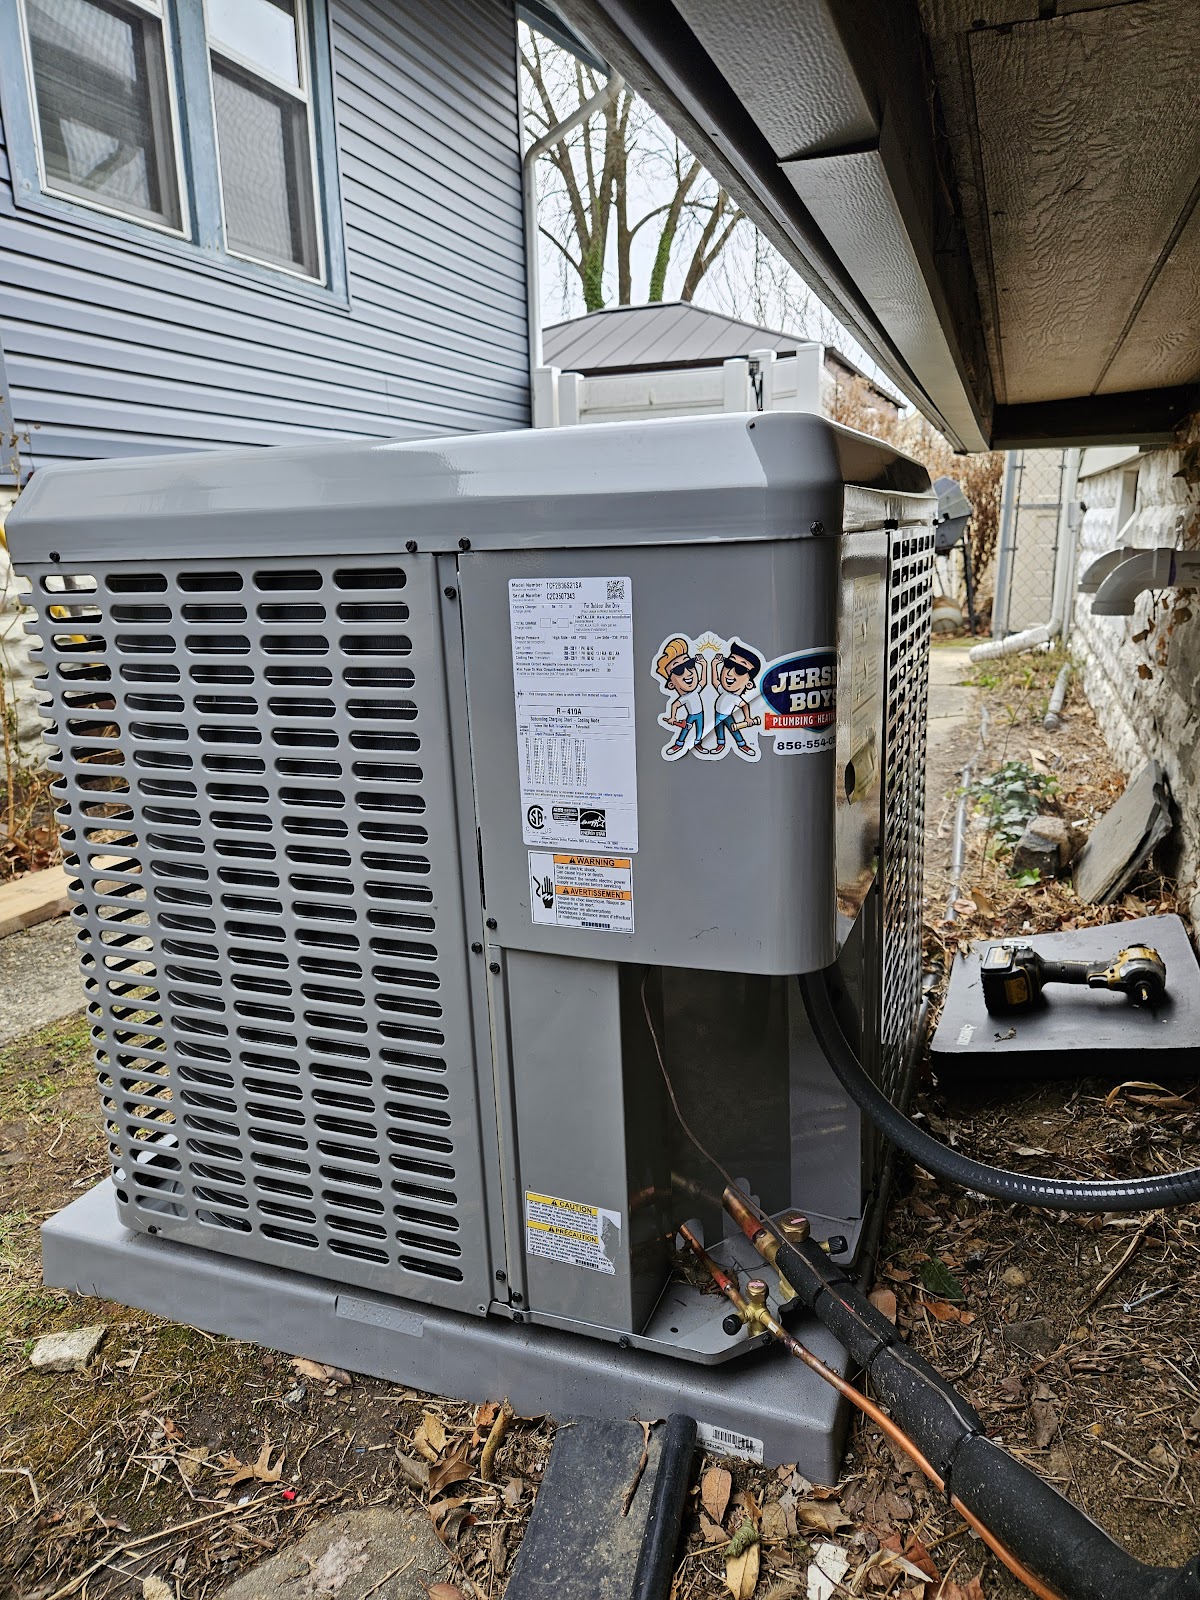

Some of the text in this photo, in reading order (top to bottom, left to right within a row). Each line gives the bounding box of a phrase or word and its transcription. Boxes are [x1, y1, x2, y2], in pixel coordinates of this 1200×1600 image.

[773, 715, 813, 727] PLUMBING
[577, 858, 615, 866] WARNING
[571, 888, 624, 899] AVERTISSEMENT
[560, 1201, 592, 1213] CAUTION
